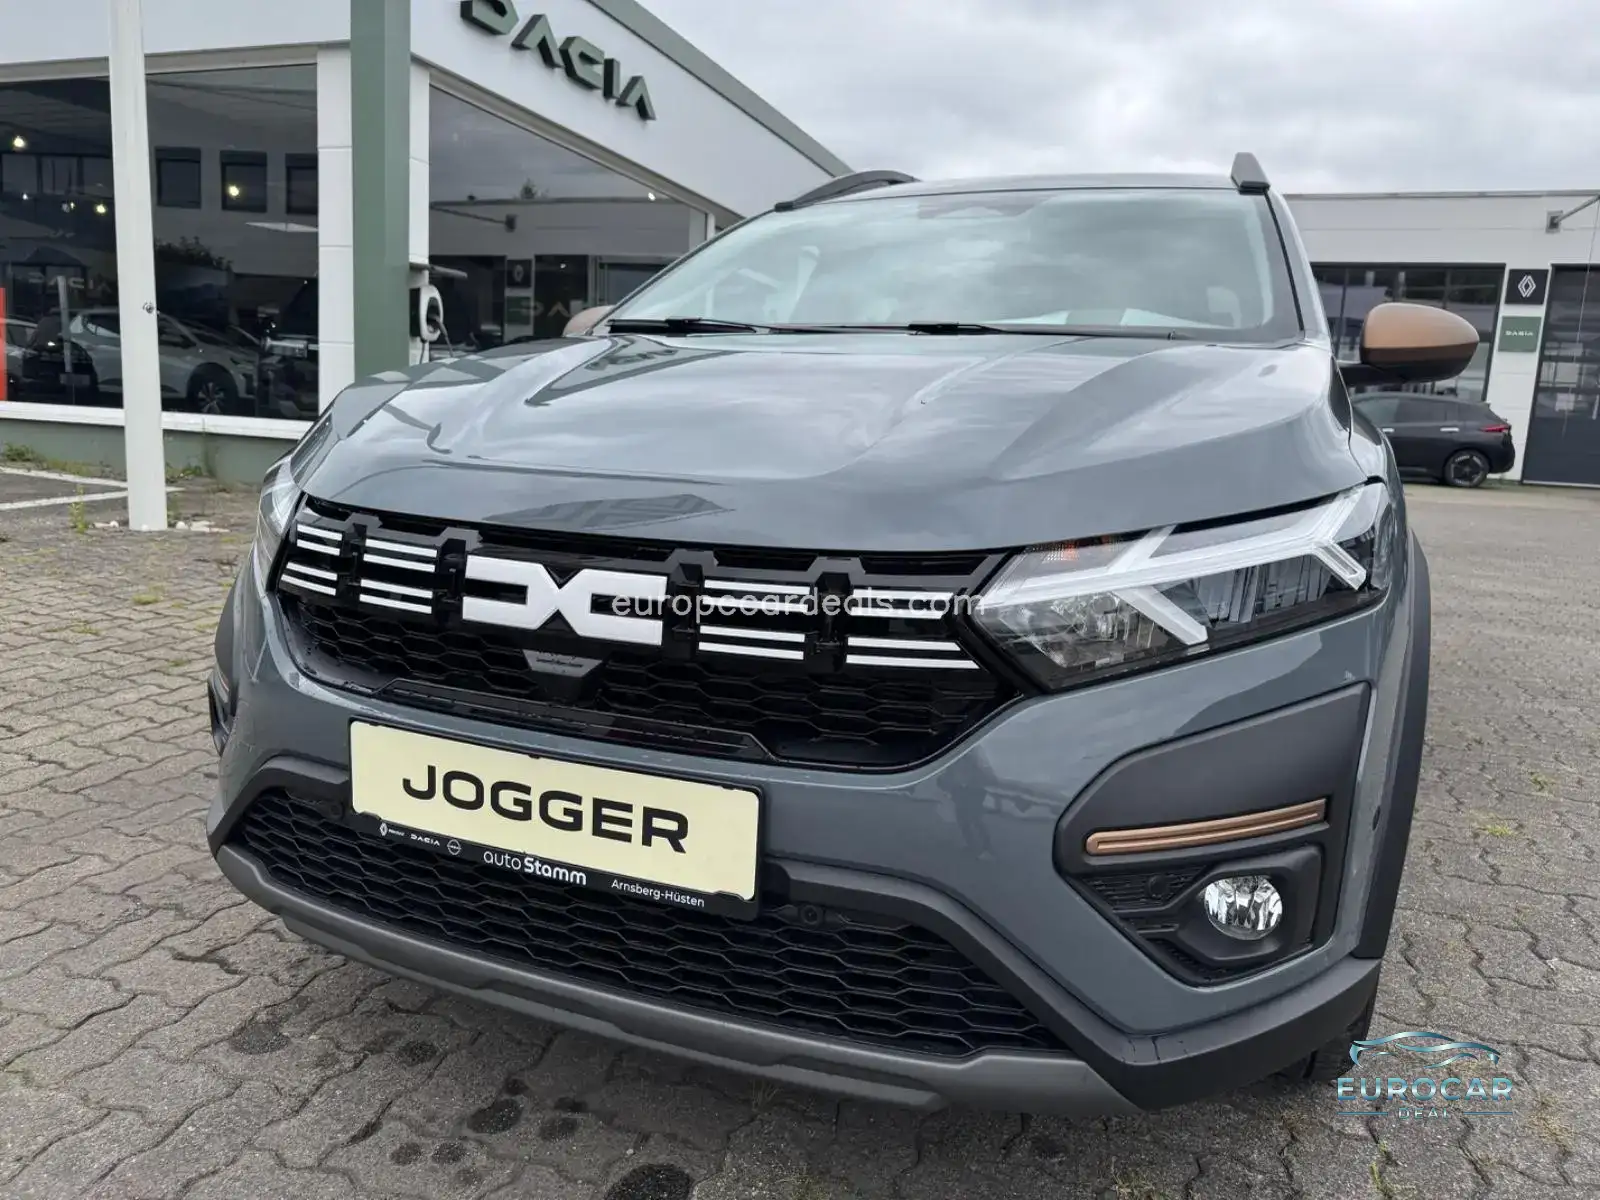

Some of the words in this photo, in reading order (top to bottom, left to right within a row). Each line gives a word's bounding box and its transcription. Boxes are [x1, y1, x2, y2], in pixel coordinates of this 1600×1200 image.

[460, 0, 656, 120] DACIA
[402, 765, 690, 854] JOGGER
[410, 833, 441, 847] DACIA
[483, 850, 522, 871] auto
[523, 856, 588, 886] Stamm
[611, 879, 705, 908] Arnsberg-Hüsten
